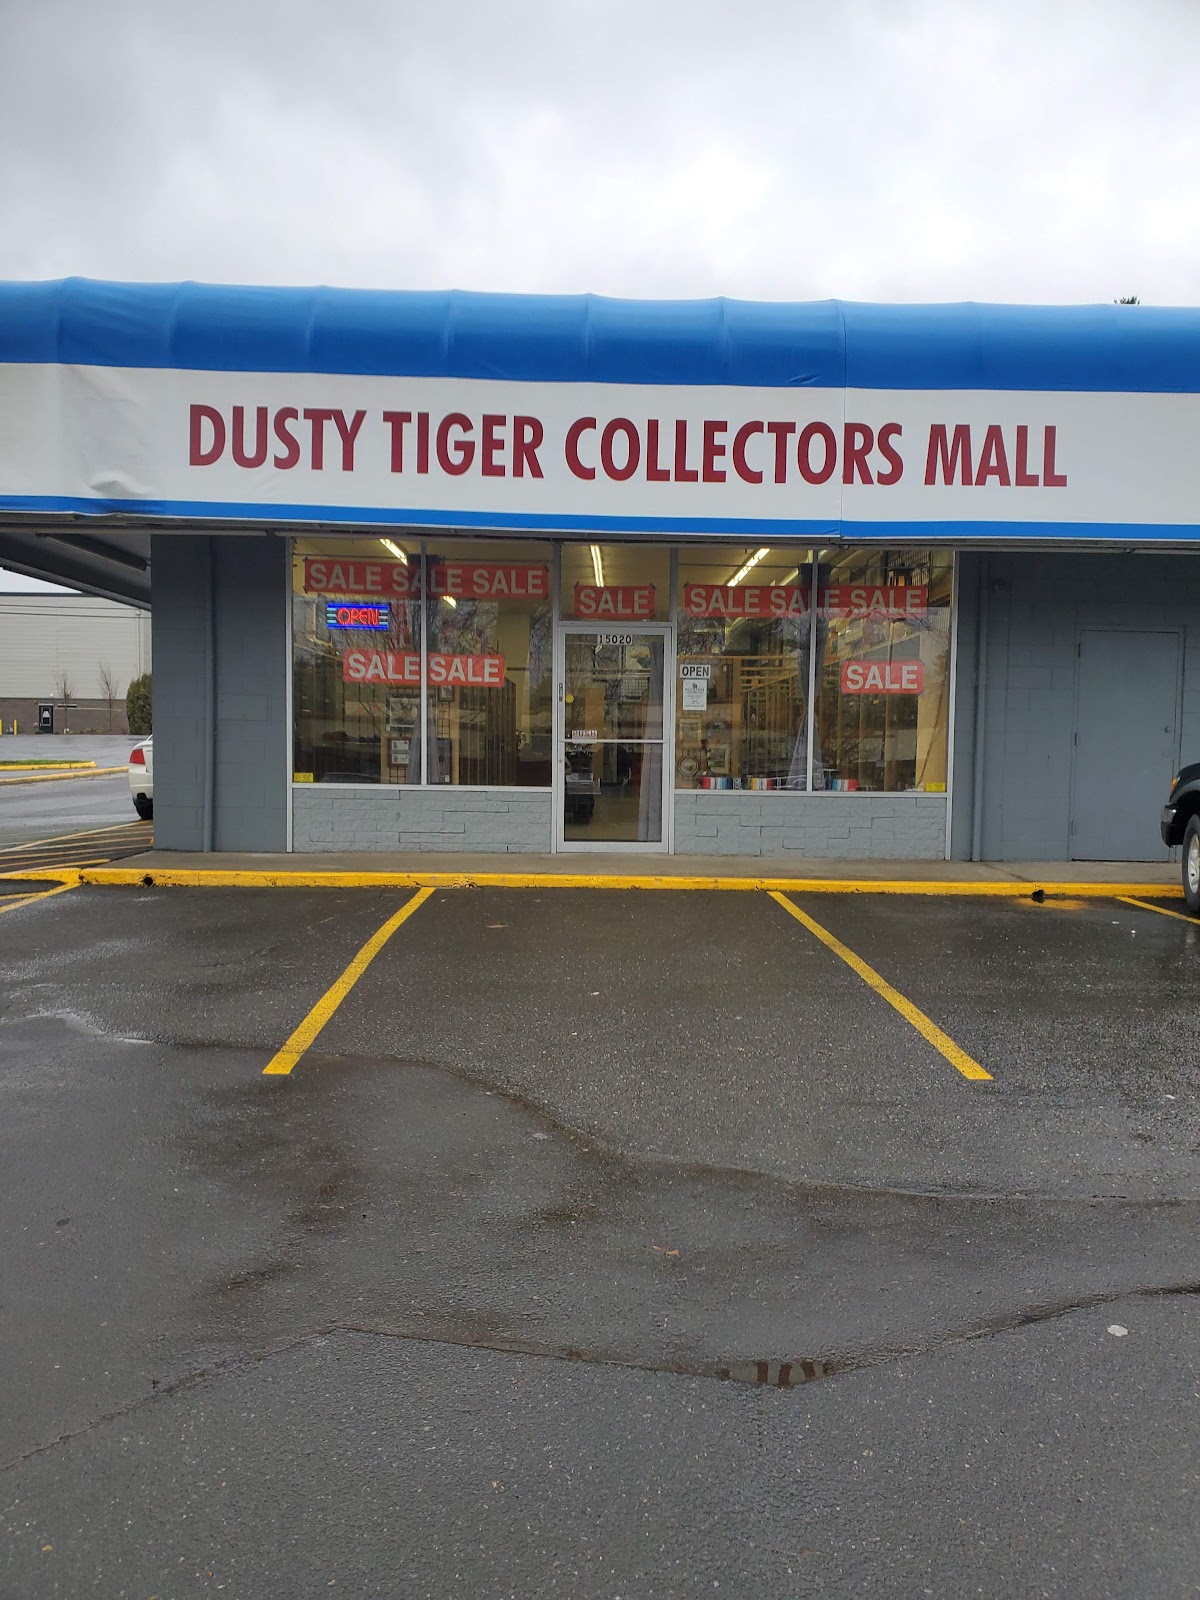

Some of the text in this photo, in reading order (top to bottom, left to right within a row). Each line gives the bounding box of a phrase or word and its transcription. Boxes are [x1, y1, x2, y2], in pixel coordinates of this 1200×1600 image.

[189, 404, 1068, 487] DUSTY TIGER COLLECTORS MALL
[309, 563, 544, 594] SALE SALE SALE
[579, 588, 650, 614] SALE
[690, 588, 760, 613] SALE
[850, 589, 922, 614] SALE
[337, 607, 379, 626] OPEN
[598, 634, 632, 644] 15020
[348, 653, 500, 683] SALE SALE
[681, 665, 710, 677] OPEN
[846, 664, 918, 690] SALE
